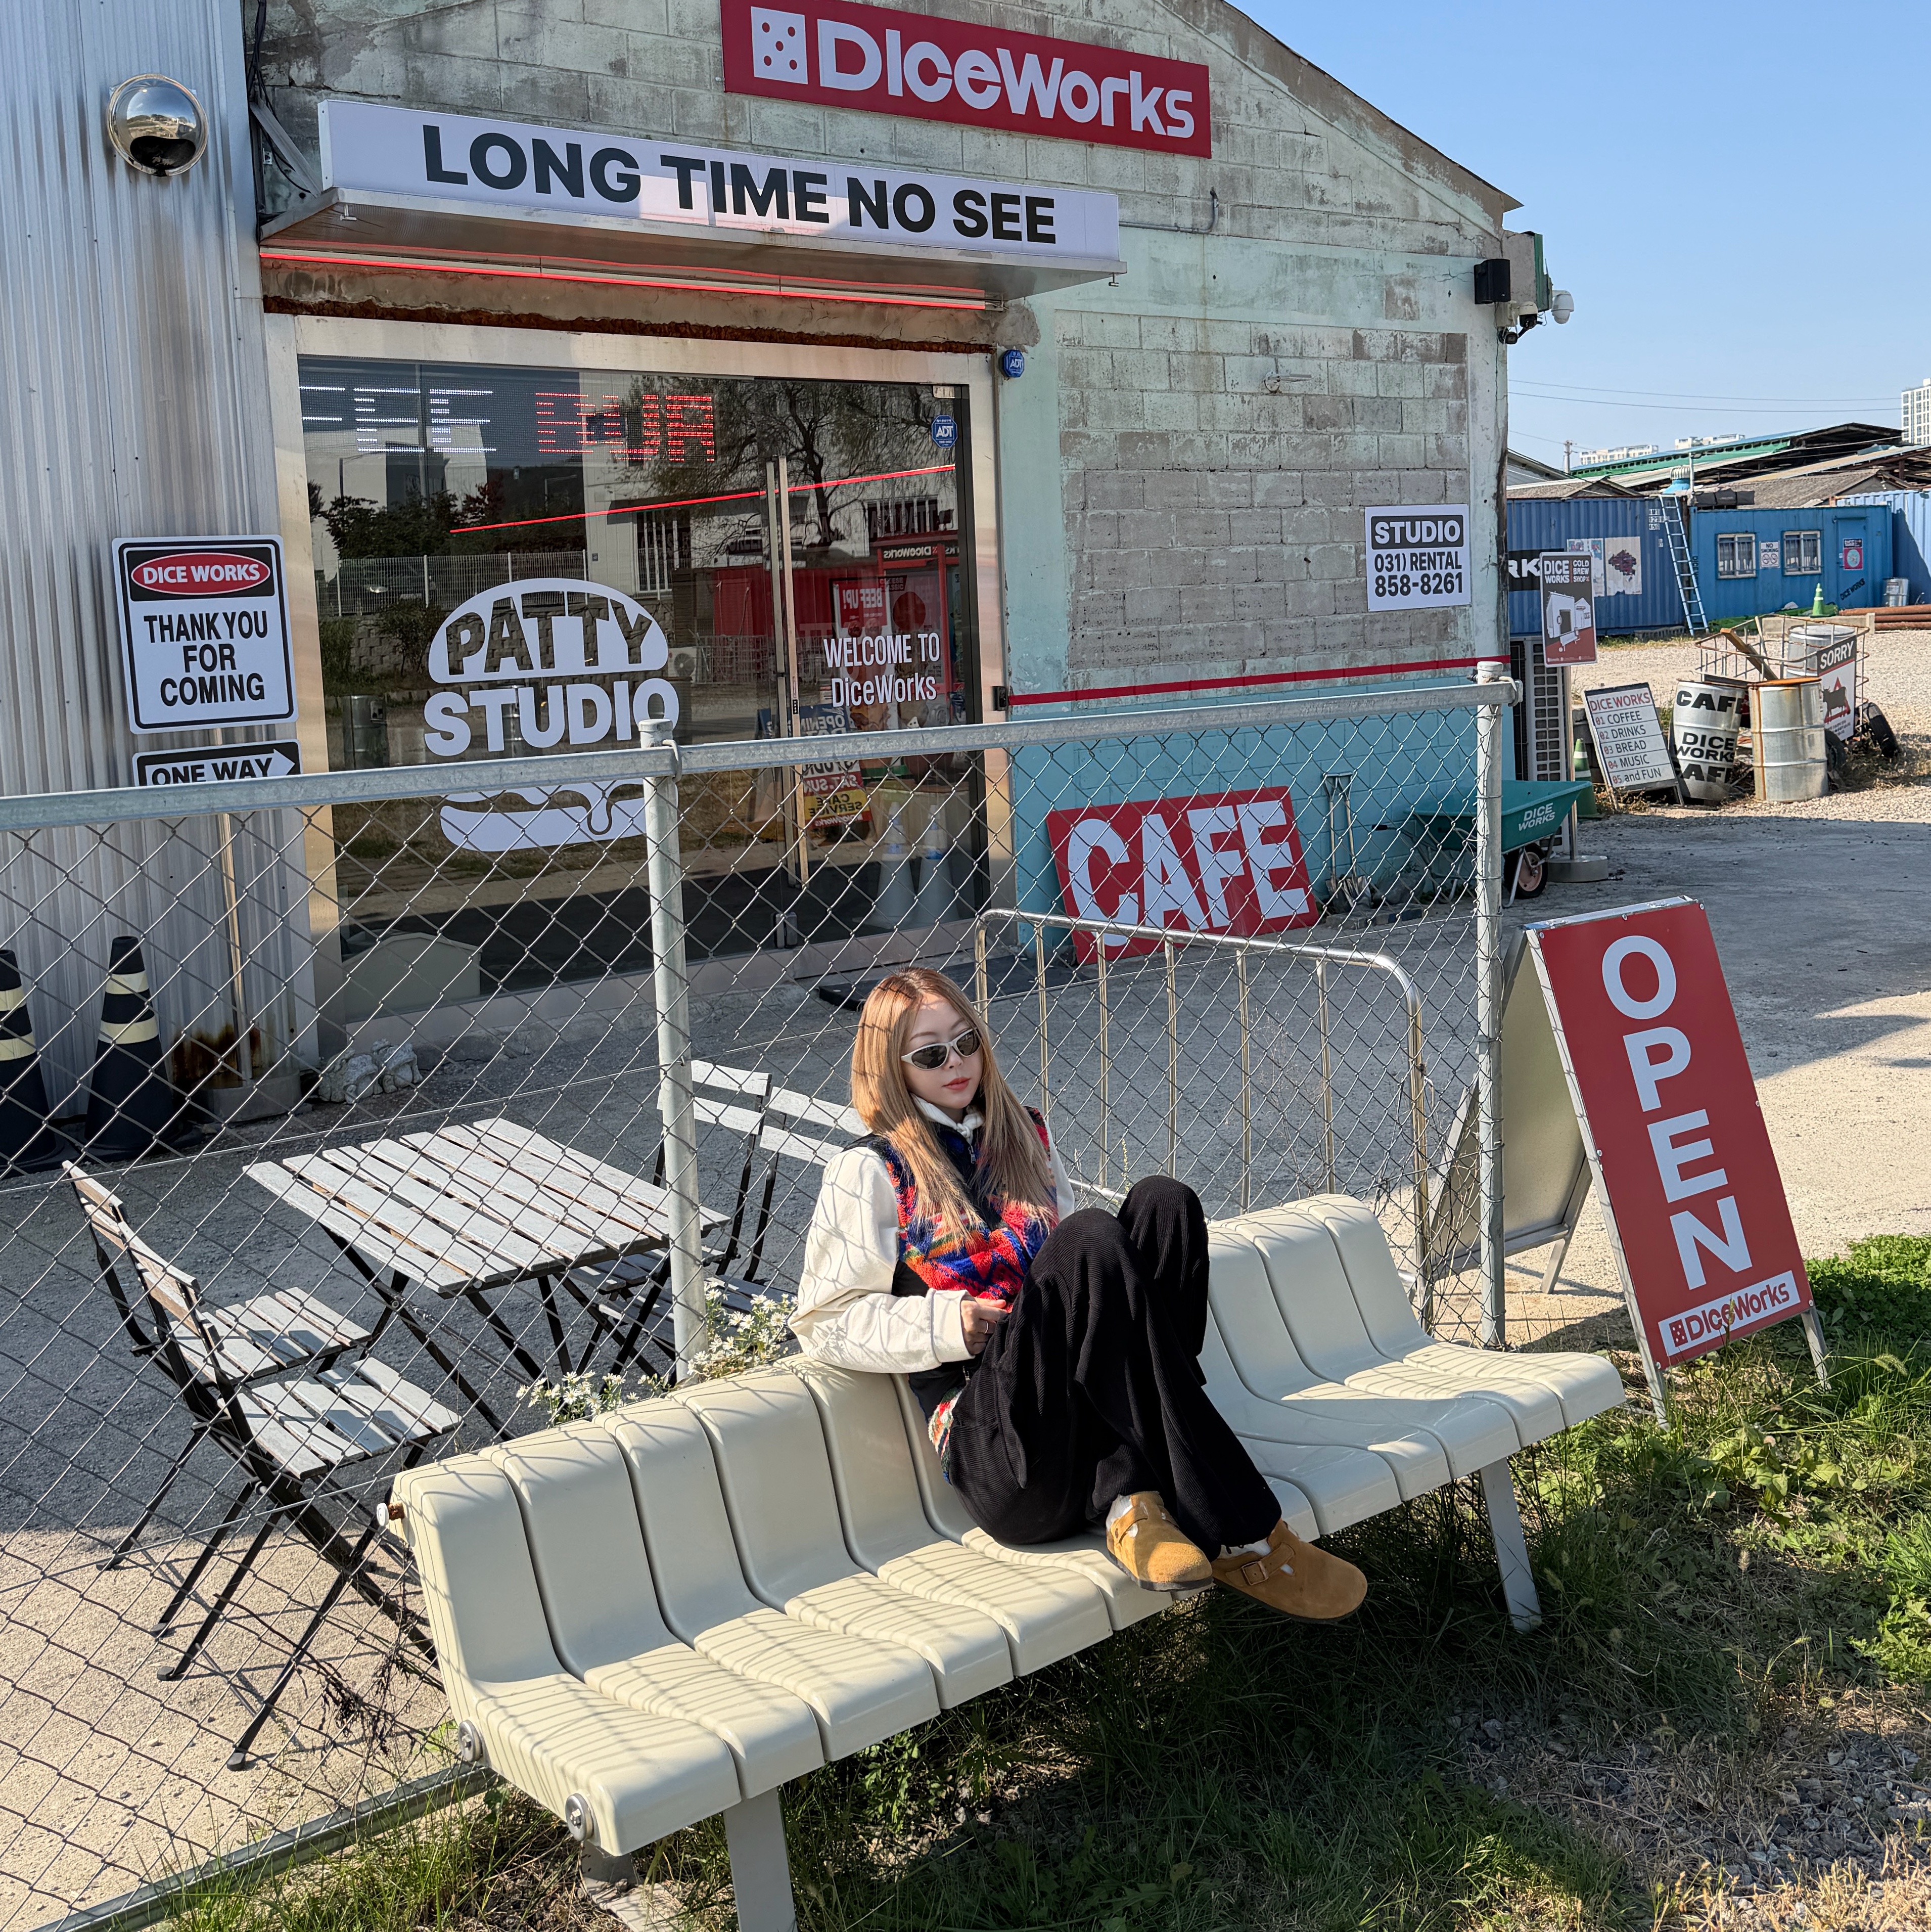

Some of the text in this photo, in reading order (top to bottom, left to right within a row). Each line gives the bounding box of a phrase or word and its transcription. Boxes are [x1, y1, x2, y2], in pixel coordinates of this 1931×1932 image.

[423, 125, 1056, 244] LONG TIME NO SEE
[1009, 358, 1022, 369] ADT
[936, 426, 953, 437] ADT
[1374, 520, 1460, 544] STUDIO
[1374, 551, 1462, 572] 031) RENTAL
[1544, 560, 1570, 575] DICE
[143, 564, 260, 584] DICE WORKS
[1375, 572, 1462, 597] 858-8261
[1545, 575, 1570, 583] WORKS
[144, 611, 268, 643] THANK YOU
[445, 591, 653, 676] PATTY
[182, 644, 237, 673] FOR
[823, 633, 940, 668] WELCOME TO
[1820, 640, 1854, 669] SORRY
[160, 672, 265, 707] COMING
[832, 672, 937, 707] DiceWorks
[1589, 692, 1651, 711] DICE WORKS
[424, 678, 679, 756] STUDIO
[1595, 710, 1642, 726] 01 COFFEE
[1599, 725, 1646, 740] 02 DRINKS
[1682, 732, 1735, 750] DICE
[1603, 740, 1647, 754] 03 BREAD
[152, 757, 273, 785] ONE WAY
[1608, 754, 1650, 769] 04 MUSIC
[1613, 768, 1662, 784] 05 and FUN
[1518, 812, 1556, 832] WORKS
[1524, 802, 1554, 822] DICE
[1067, 800, 1310, 947] CAFE
[1601, 934, 1753, 1291] OPEN
